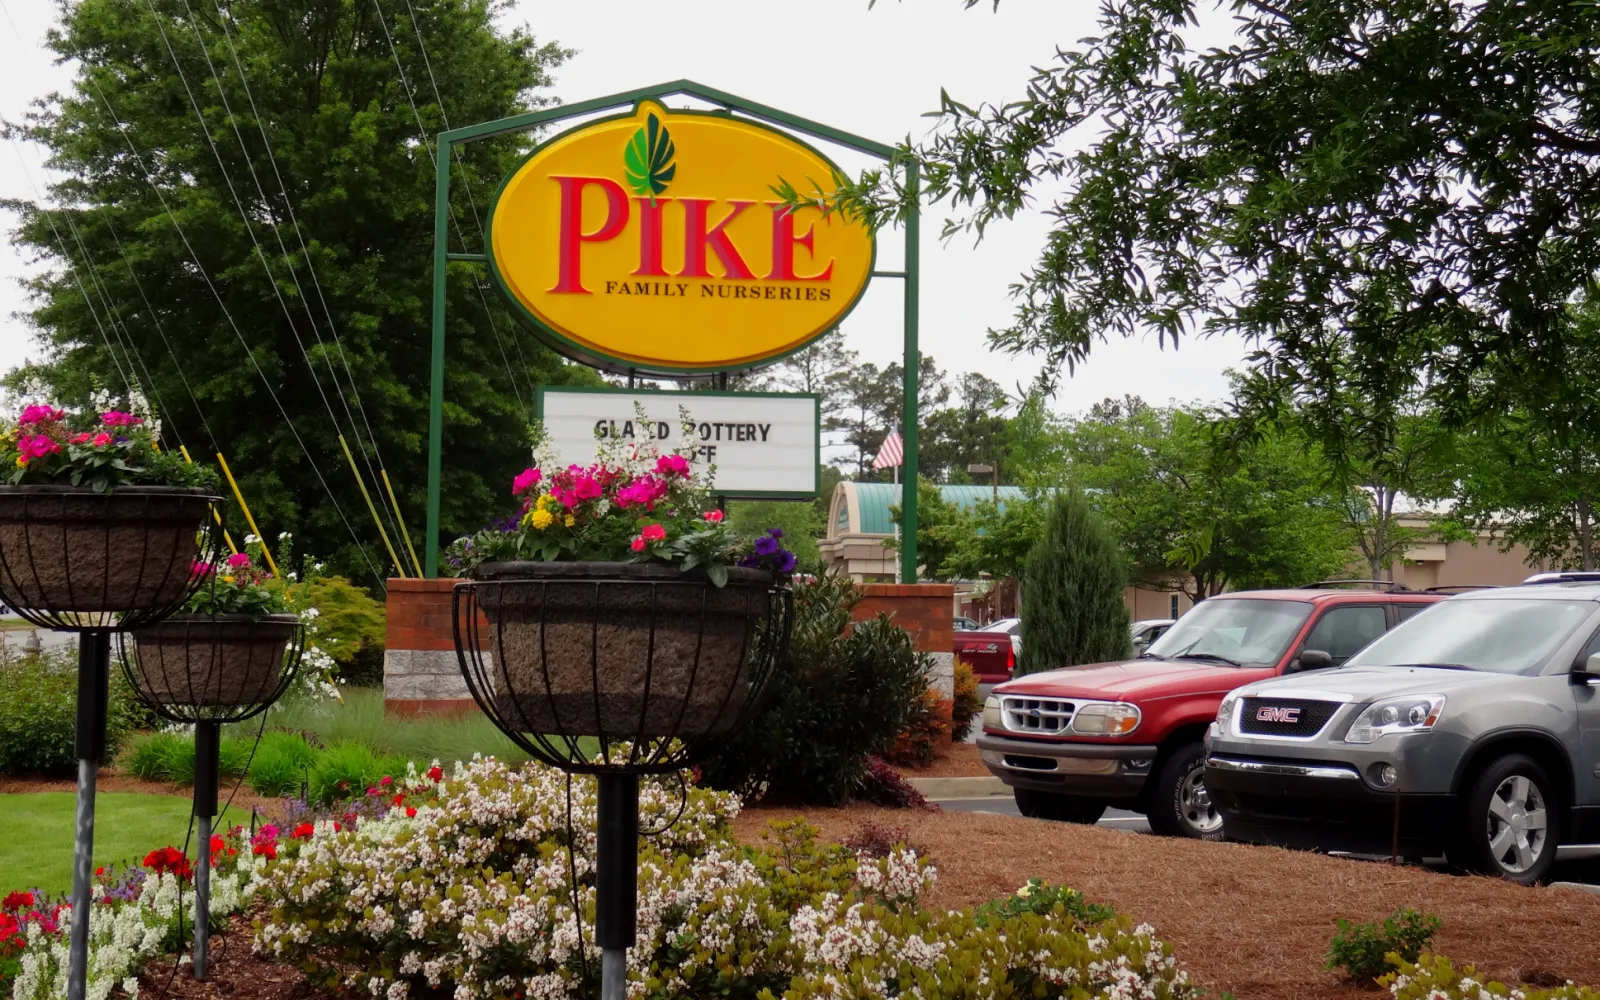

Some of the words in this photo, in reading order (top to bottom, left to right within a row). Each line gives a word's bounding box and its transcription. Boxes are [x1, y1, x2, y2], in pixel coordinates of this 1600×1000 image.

[546, 173, 836, 296] PIKE
[604, 280, 690, 297] FAMILY
[700, 284, 832, 302] NURSERIES
[595, 419, 670, 440] GLAED
[684, 444, 717, 463] FF
[1256, 706, 1301, 723] GMC
